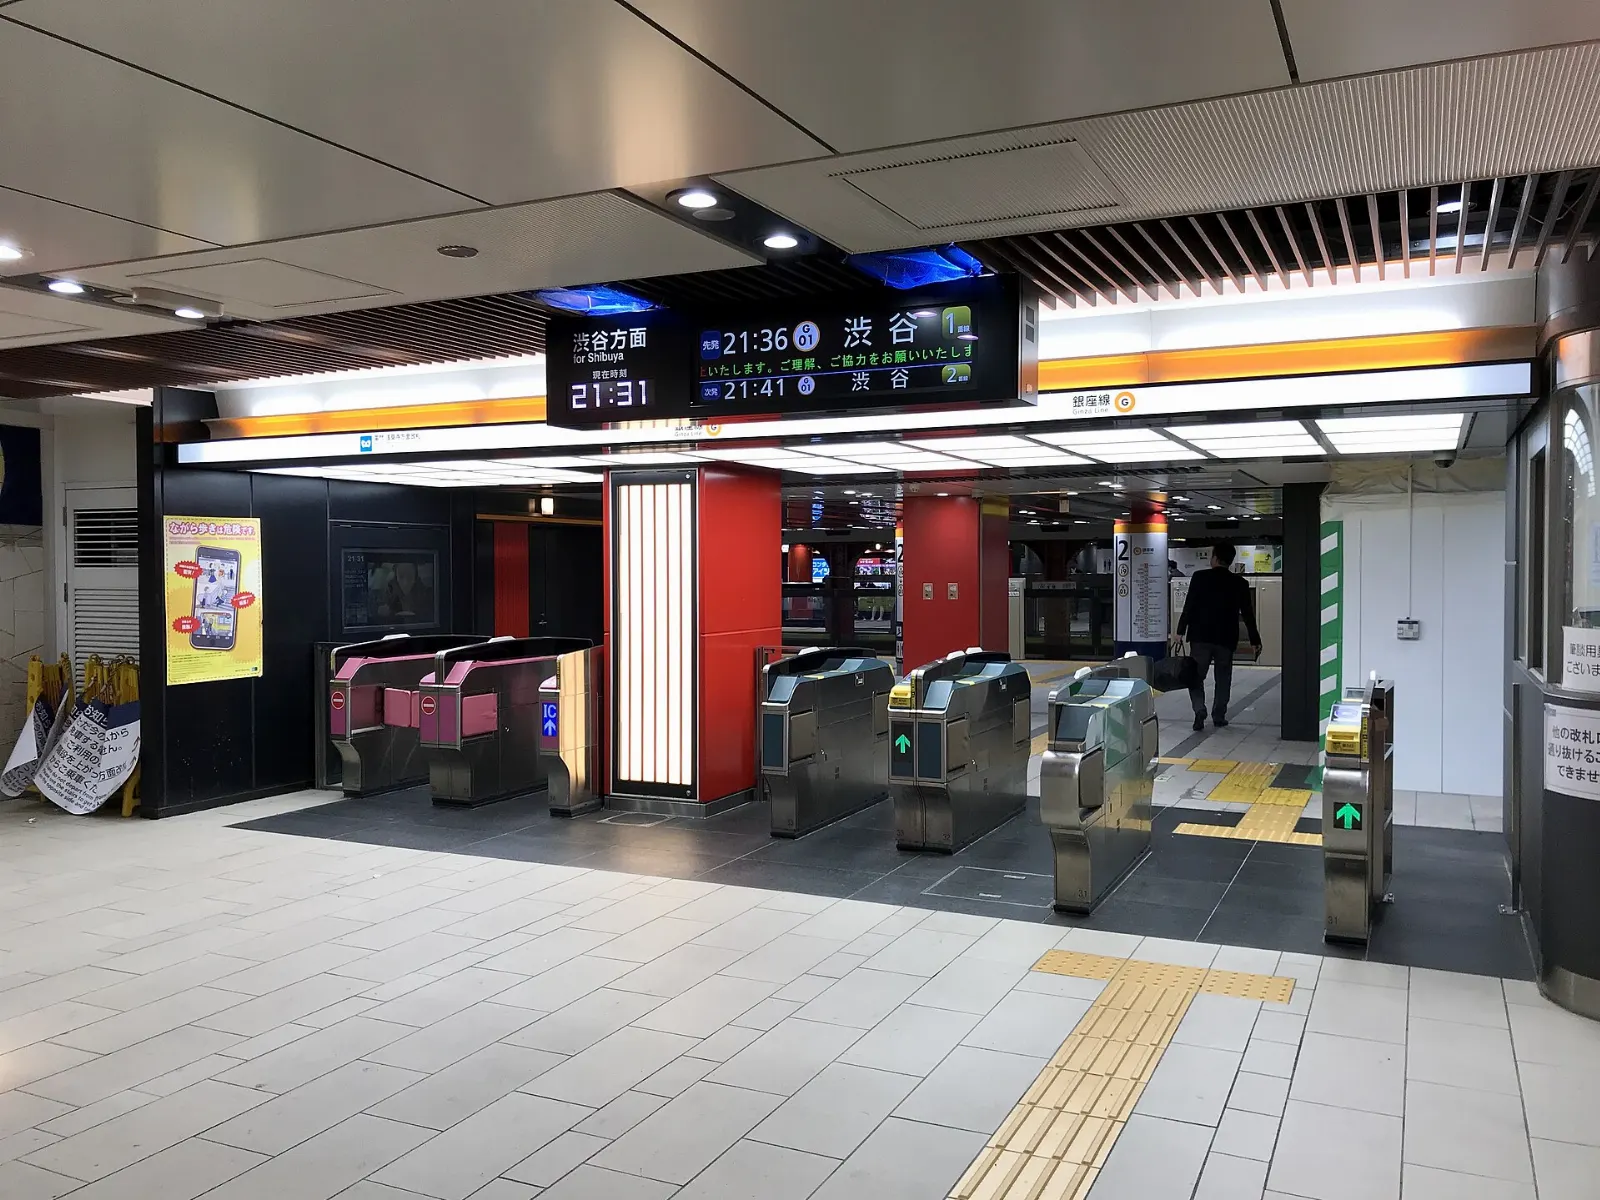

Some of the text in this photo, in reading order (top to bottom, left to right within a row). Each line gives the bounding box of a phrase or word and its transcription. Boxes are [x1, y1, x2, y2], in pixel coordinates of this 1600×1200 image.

[802, 324, 810, 333] G
[844, 311, 918, 348] 渋谷
[573, 327, 647, 352] 渋谷方面
[702, 327, 788, 355] 先発 21:36
[798, 335, 813, 346] 01
[573, 352, 624, 364] for Shibuya
[592, 369, 627, 379] 現在時刻
[852, 368, 909, 392] 渋谷
[572, 380, 647, 409] 21:31
[724, 378, 784, 400] 21:41
[1073, 394, 1110, 407] 銀座線
[1121, 398, 1129, 406] G
[1118, 540, 1129, 560] 2
[543, 704, 557, 719] IC
